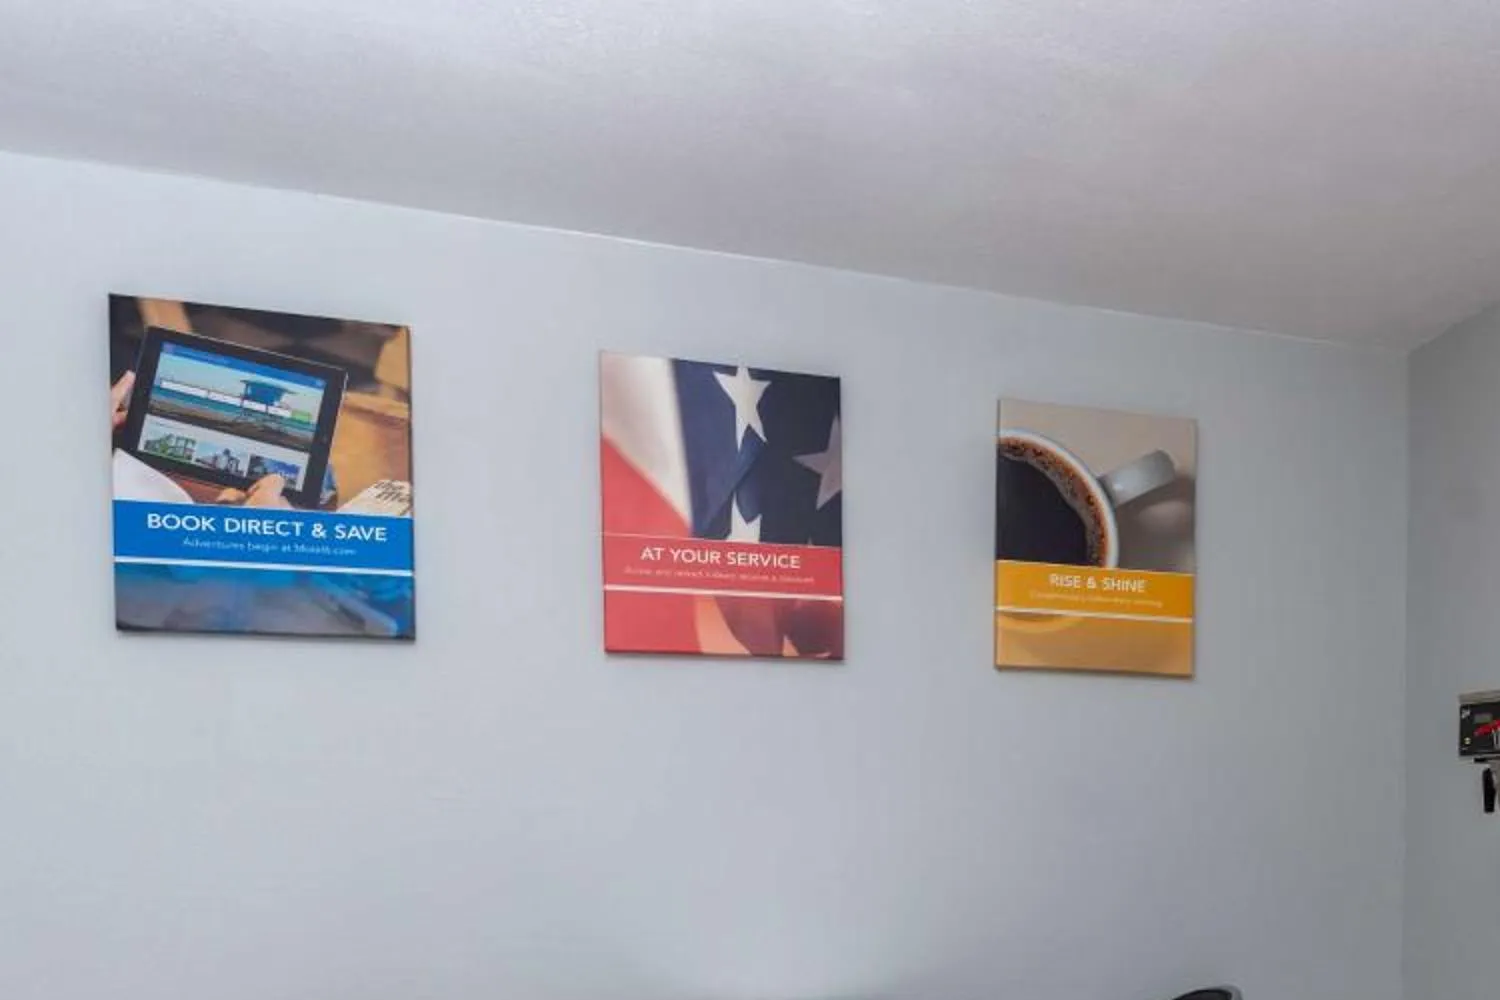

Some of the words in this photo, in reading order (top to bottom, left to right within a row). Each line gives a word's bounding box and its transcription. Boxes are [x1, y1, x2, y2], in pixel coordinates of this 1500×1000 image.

[147, 513, 216, 532] BOOK
[223, 517, 304, 537] DIRECT
[311, 522, 327, 539] &
[334, 524, 388, 542] SAVE
[640, 547, 664, 561] AT
[670, 549, 720, 565] YOUR
[727, 551, 801, 569] SERVICE
[1049, 573, 1081, 589] RISE
[1087, 575, 1097, 589] &
[1103, 577, 1145, 593] SHINE
